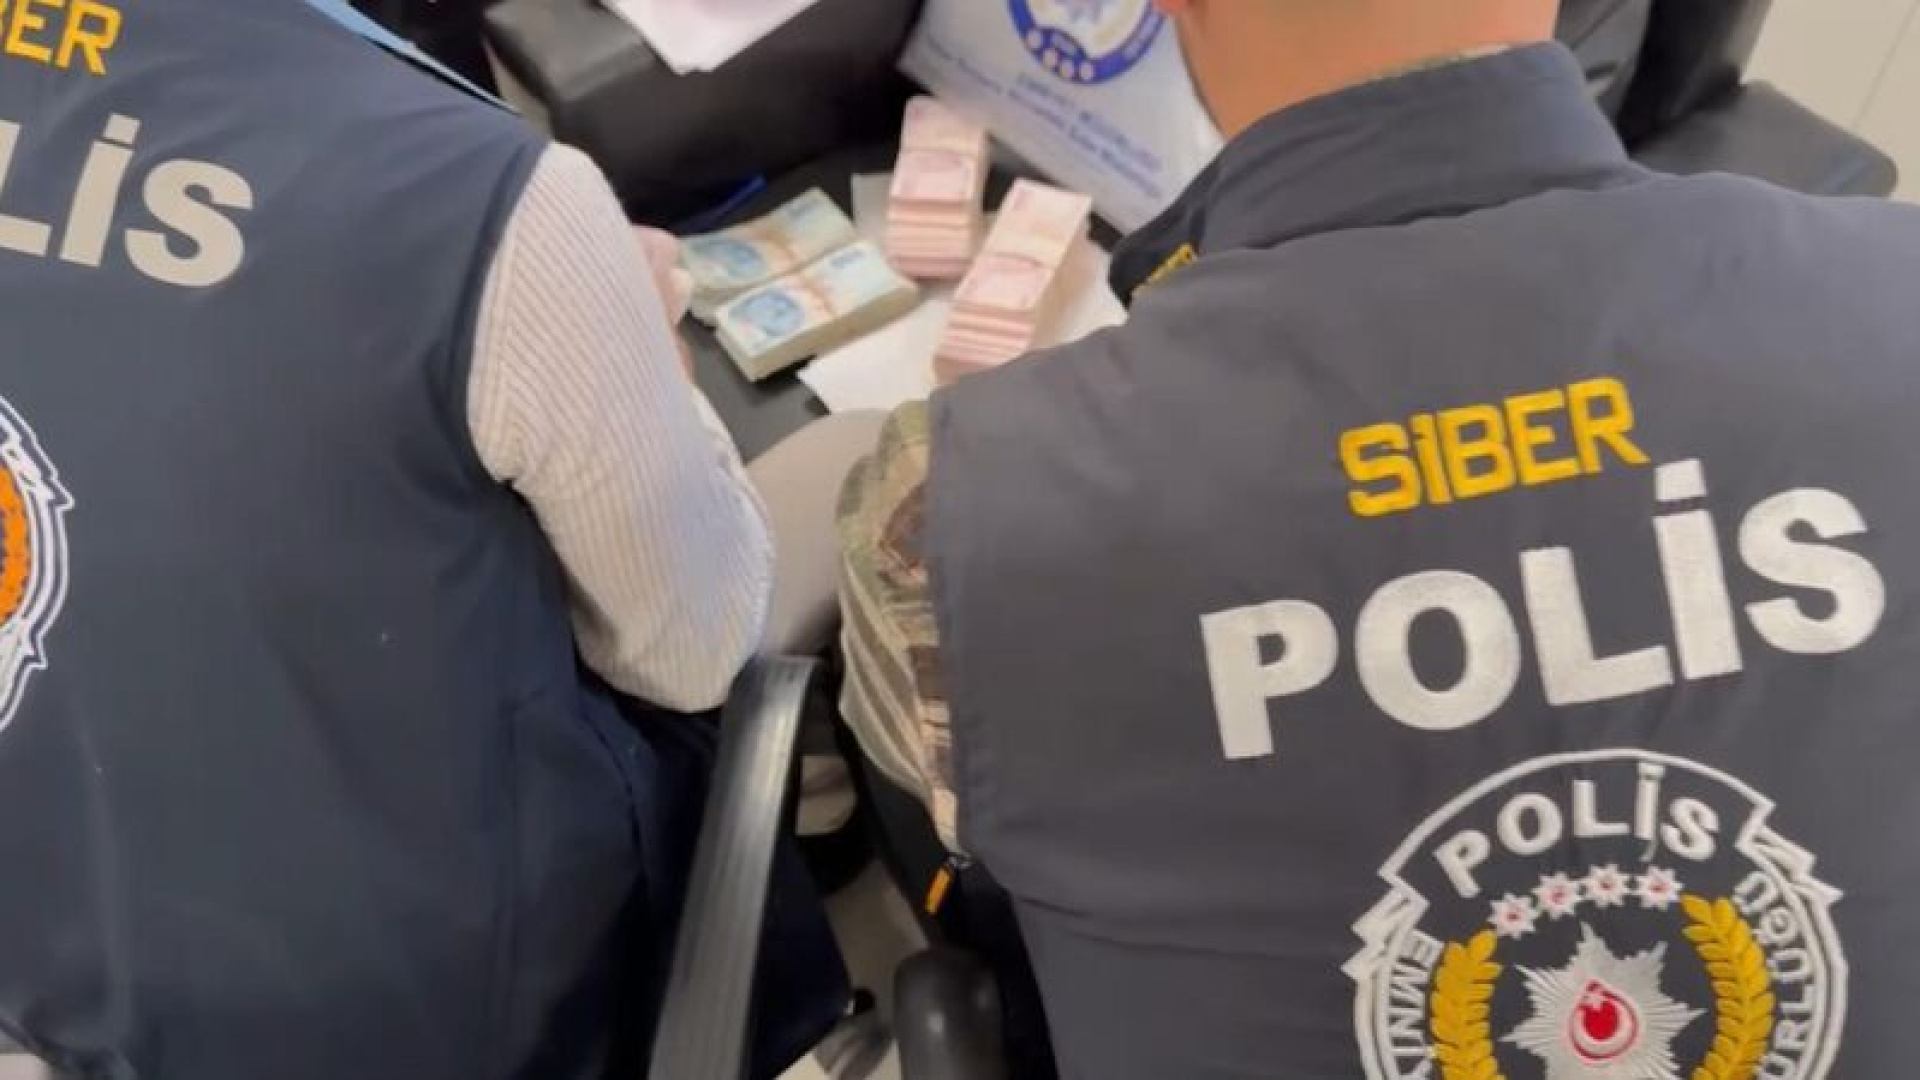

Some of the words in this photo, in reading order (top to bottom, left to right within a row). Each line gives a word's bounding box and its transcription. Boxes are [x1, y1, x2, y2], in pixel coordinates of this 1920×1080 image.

[0, 0, 121, 75] ER
[1200, 458, 1886, 759] POLİS
[1434, 762, 1720, 898] POLİS
